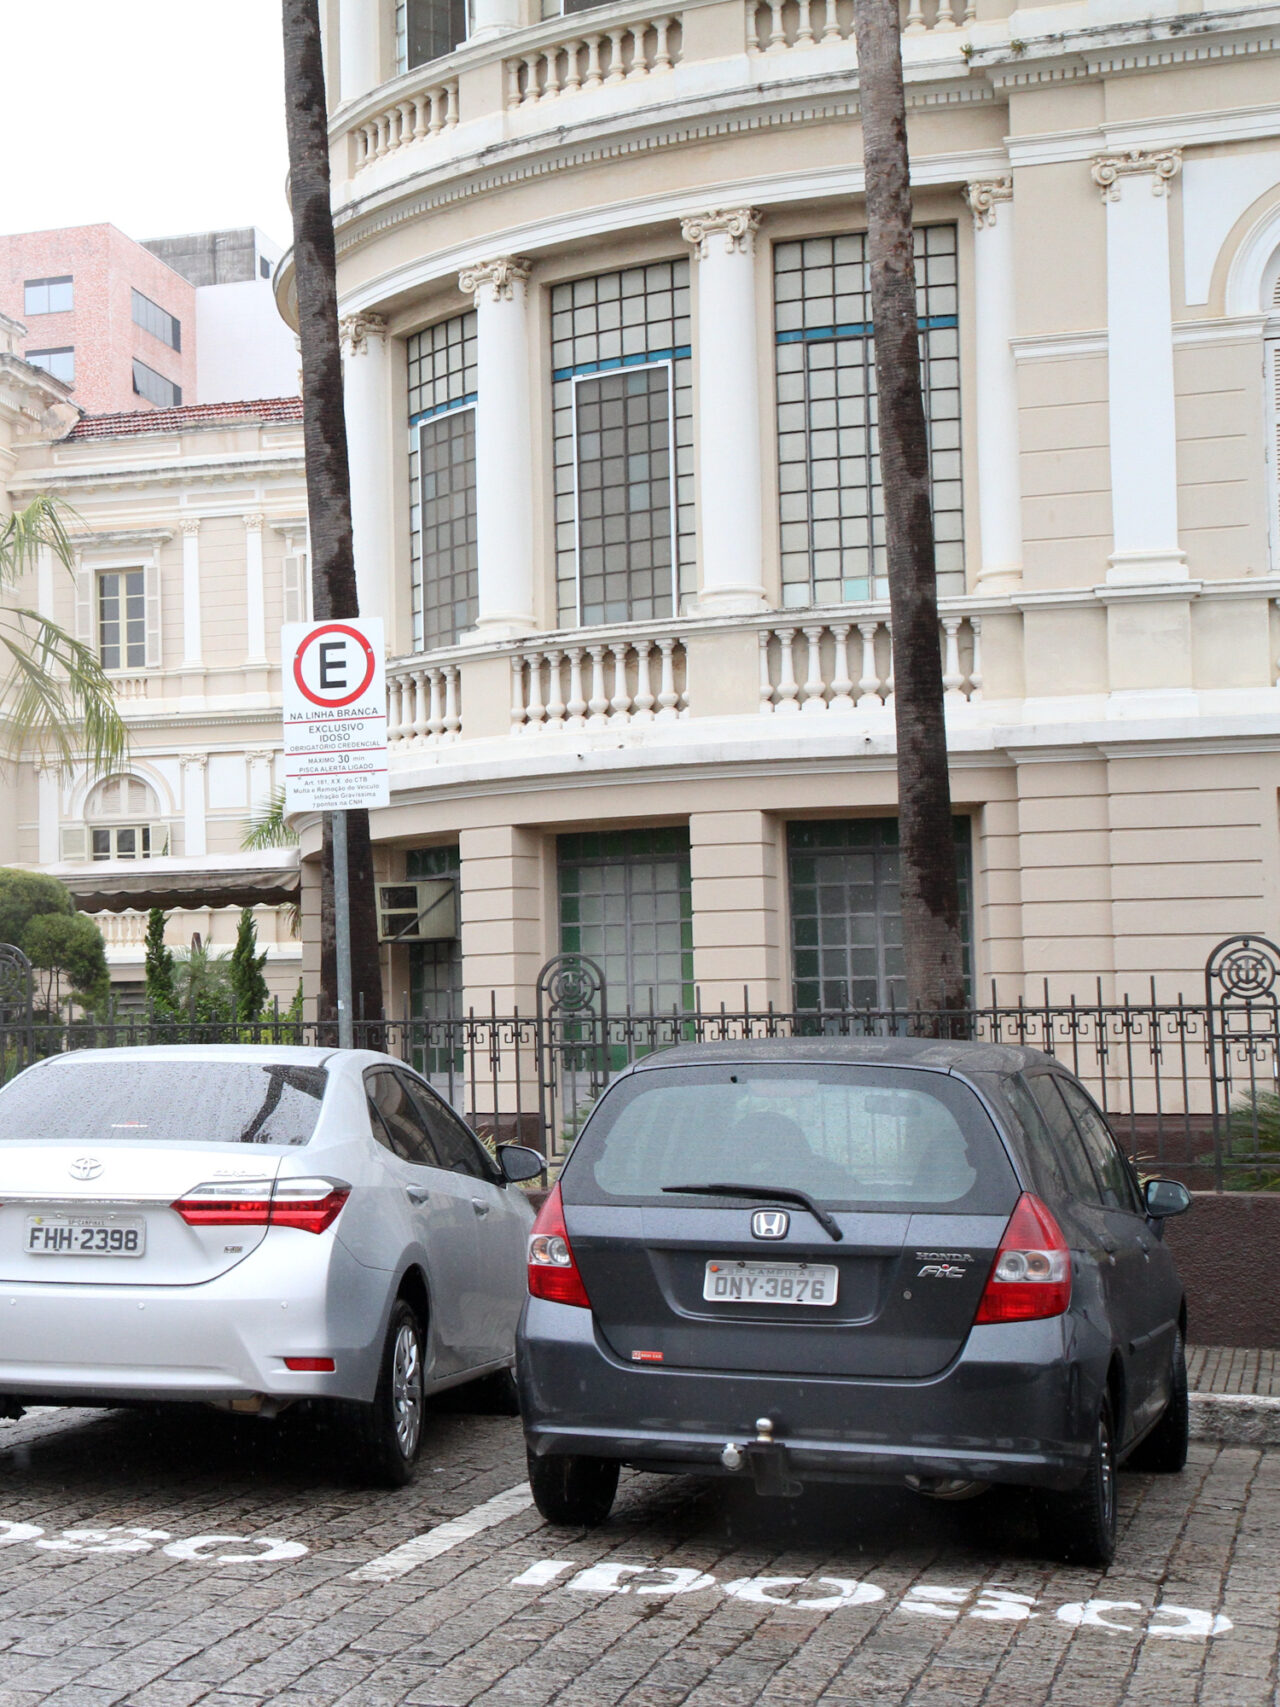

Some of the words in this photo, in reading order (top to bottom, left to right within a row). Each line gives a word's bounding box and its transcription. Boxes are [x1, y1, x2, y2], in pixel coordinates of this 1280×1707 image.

[319, 641, 347, 690] E
[290, 712, 304, 720] NA
[306, 710, 335, 719] LINHA
[337, 707, 379, 717] BRANCA
[308, 722, 364, 734] EXCLUSIVO
[319, 733, 351, 742] IDOSO
[337, 740, 381, 748] CREDENCIAL
[337, 754, 350, 763] 30
[316, 785, 346, 794] Remoção
[915, 1252, 975, 1262] HONDA
[917, 1264, 966, 1278] Fit
[511, 1559, 1233, 1636] IDOSO
